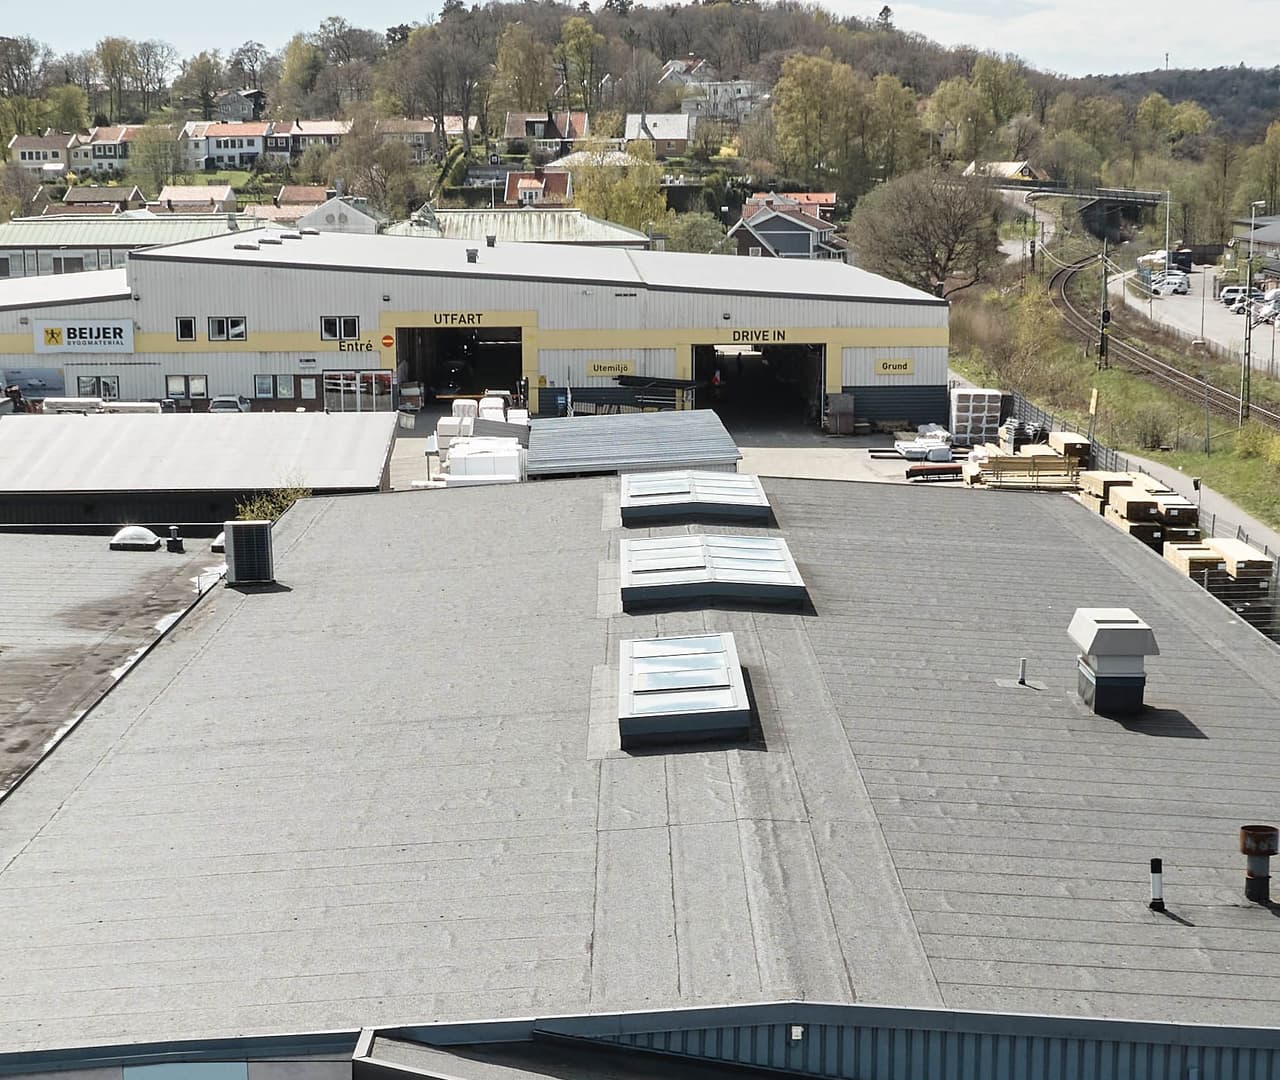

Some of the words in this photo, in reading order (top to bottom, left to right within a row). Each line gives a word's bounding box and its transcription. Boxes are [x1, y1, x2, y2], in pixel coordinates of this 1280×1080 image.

[433, 313, 484, 325] UTFART
[66, 327, 124, 340] BEIJER
[732, 330, 769, 341] DRIVE
[772, 330, 786, 341] IN
[338, 340, 373, 352] Entré
[593, 363, 629, 374] Utemiljö
[881, 361, 908, 371] Grund
